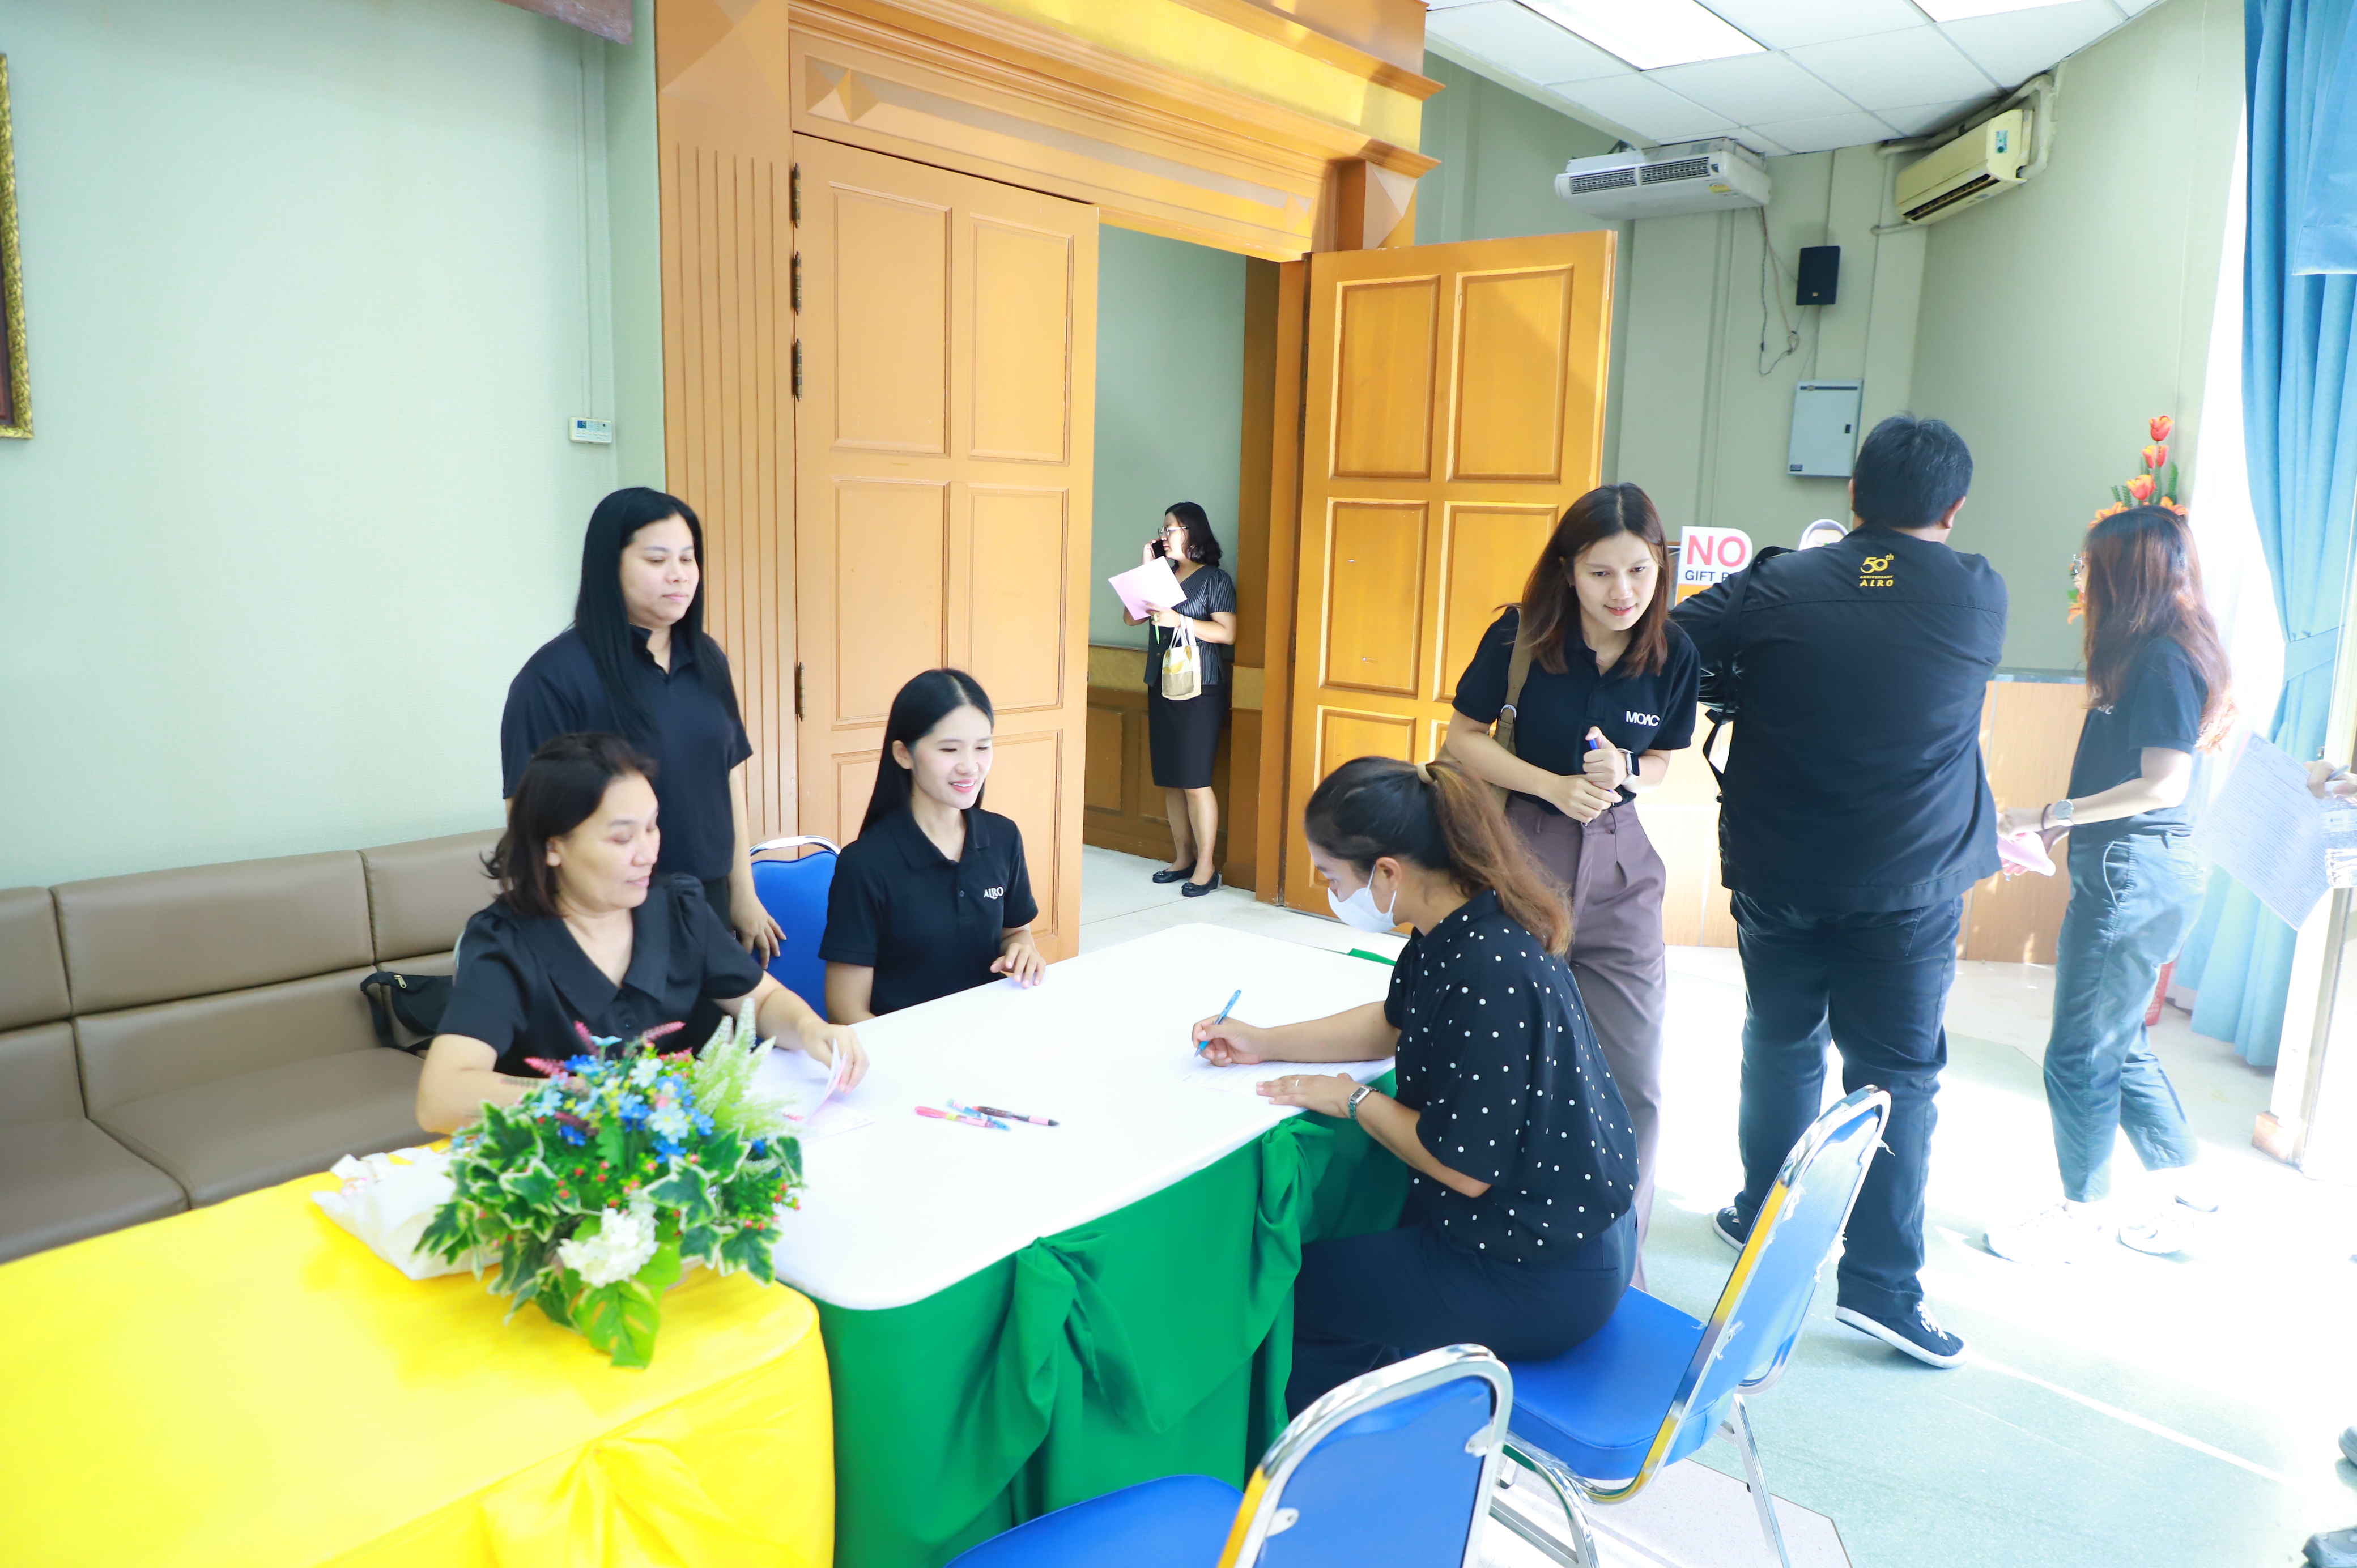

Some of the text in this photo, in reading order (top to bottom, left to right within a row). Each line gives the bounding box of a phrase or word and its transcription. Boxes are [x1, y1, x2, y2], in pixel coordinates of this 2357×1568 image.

[1687, 535, 1746, 567] NO
[1685, 570, 1716, 582] GIFT
[1626, 711, 1660, 727] MOAC
[984, 887, 1004, 900] ALRO
